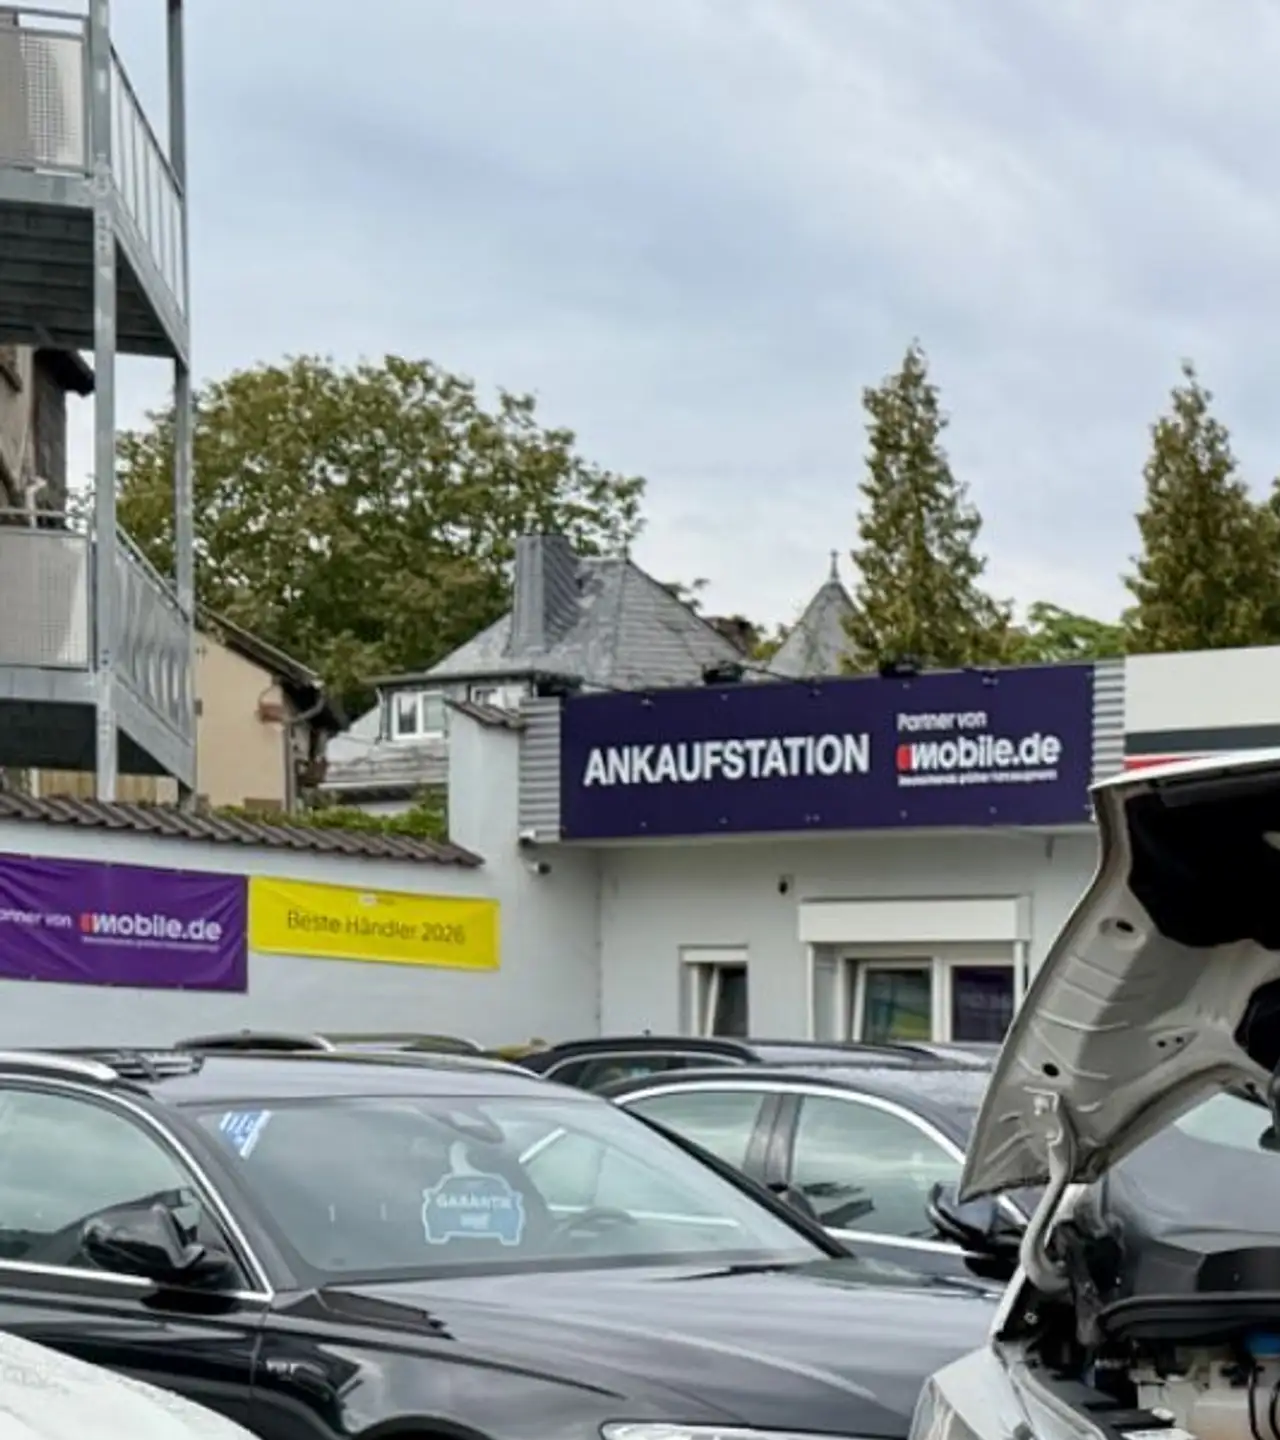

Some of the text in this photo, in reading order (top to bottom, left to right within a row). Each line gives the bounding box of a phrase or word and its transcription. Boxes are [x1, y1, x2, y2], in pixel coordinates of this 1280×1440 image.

[897, 710, 988, 732] Partner von
[583, 732, 871, 788] ANKAUFSTATION
[897, 731, 1062, 772] mobile.de
[44, 912, 72, 929] von
[81, 911, 223, 943] mobile.de
[287, 907, 467, 946] Beste Händler 2026
